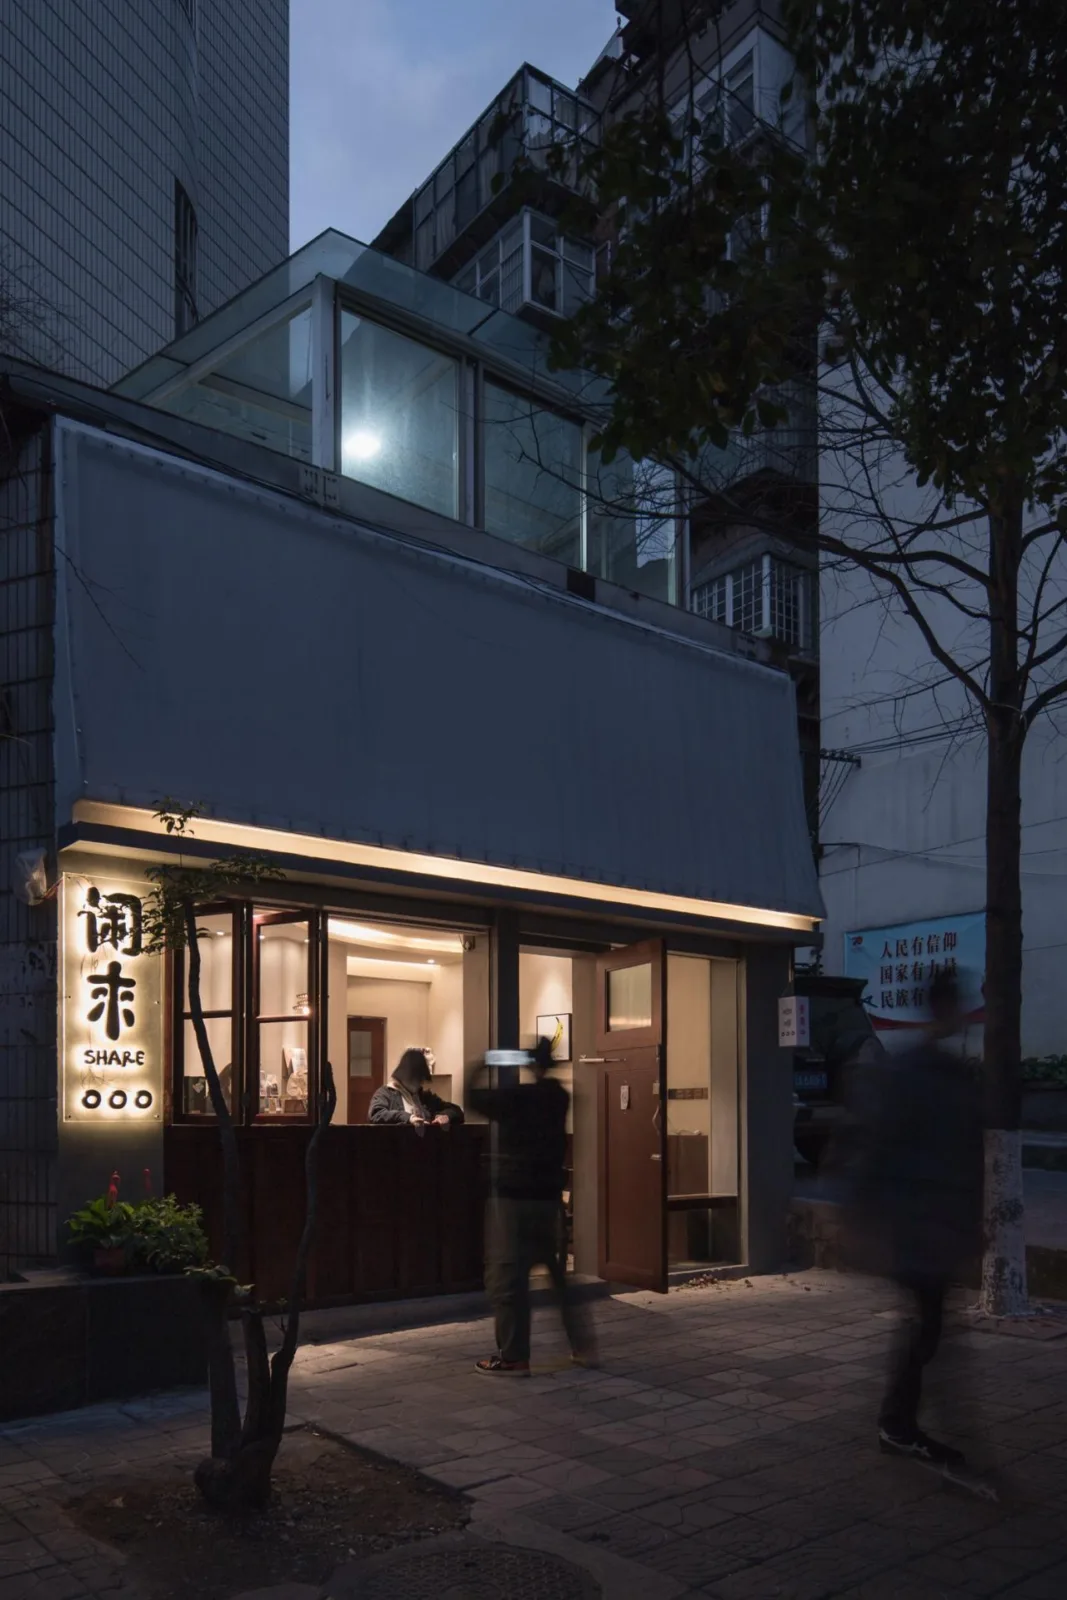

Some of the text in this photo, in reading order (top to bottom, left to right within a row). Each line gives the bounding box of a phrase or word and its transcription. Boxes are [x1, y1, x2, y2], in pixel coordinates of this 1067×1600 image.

[880, 932, 958, 959] 人民有信仰
[880, 986, 925, 1009] 民族有
[84, 1050, 145, 1067] SHARE
